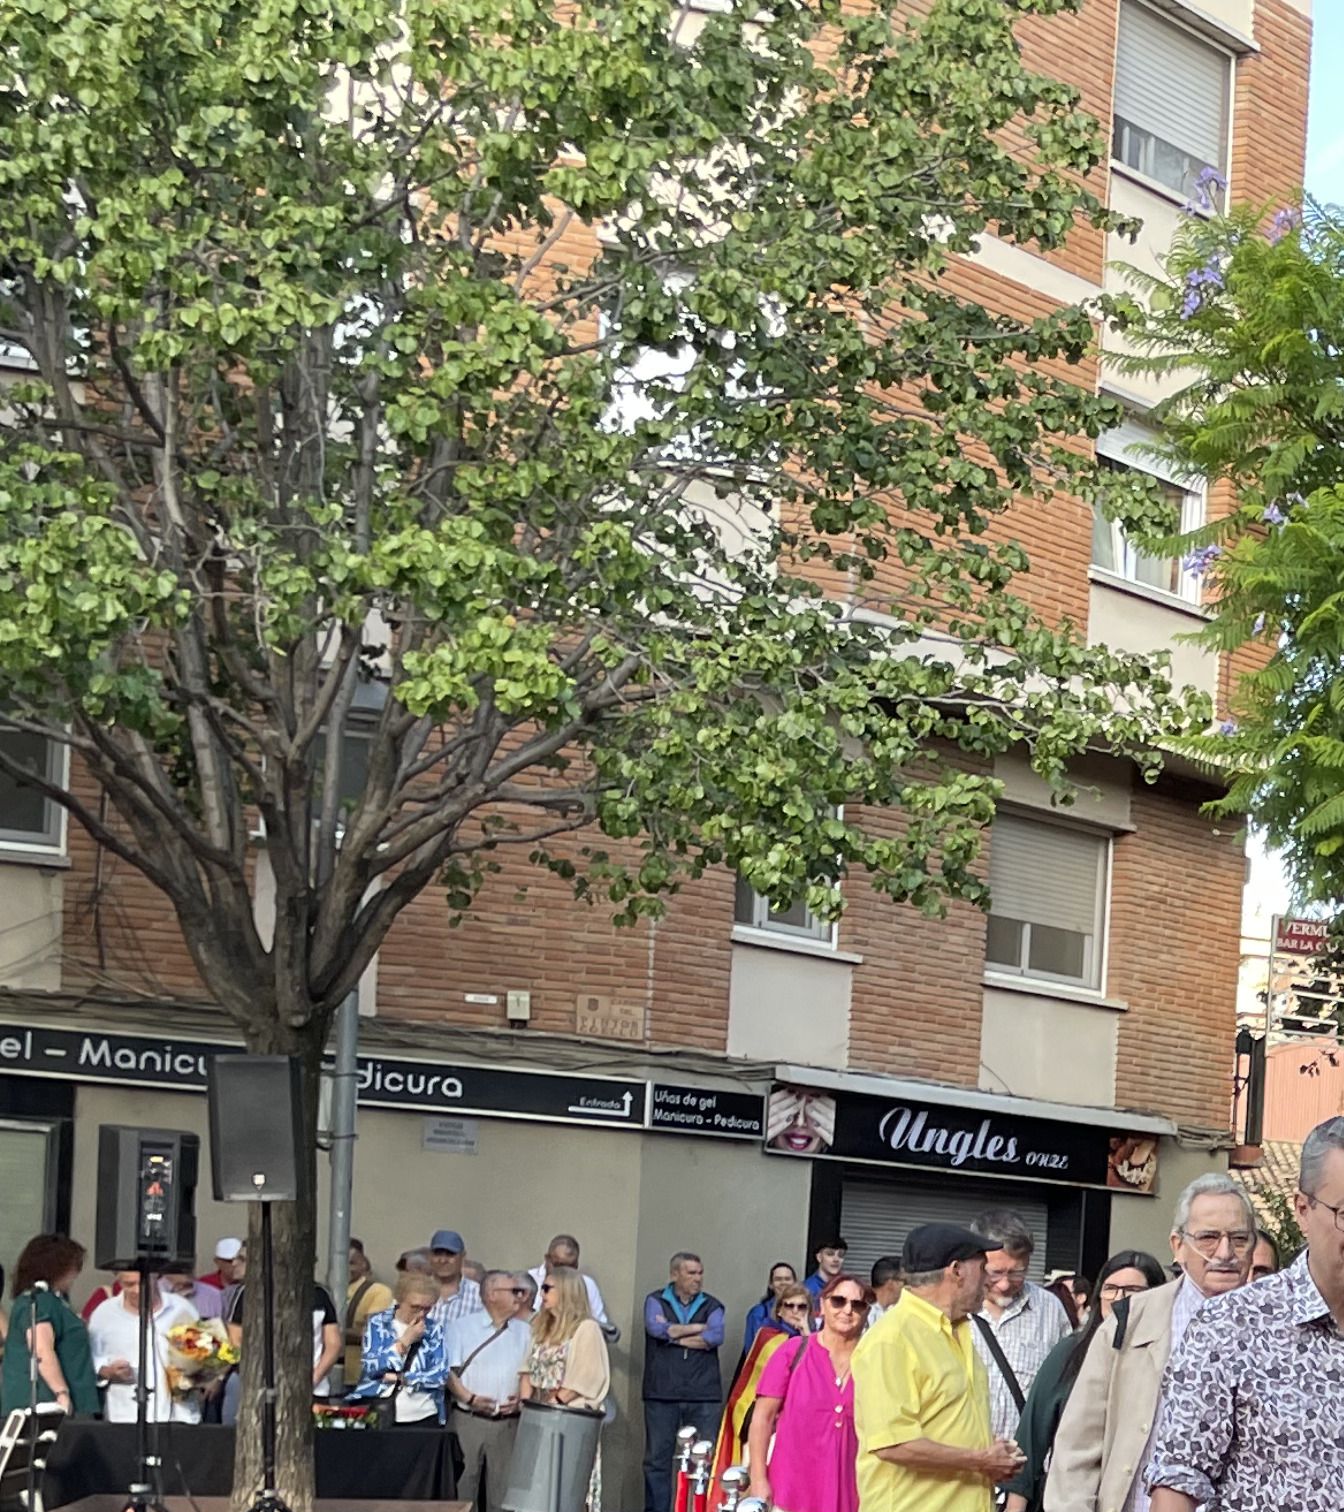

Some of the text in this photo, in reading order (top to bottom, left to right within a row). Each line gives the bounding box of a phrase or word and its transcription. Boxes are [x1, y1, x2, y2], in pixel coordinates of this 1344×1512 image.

[580, 1097, 621, 1110] Entrada
[654, 1090, 717, 1111] Uñas de gel
[653, 1108, 704, 1125] Manicura
[714, 1114, 760, 1130] Pedicura
[878, 1106, 1020, 1166] Ungles
